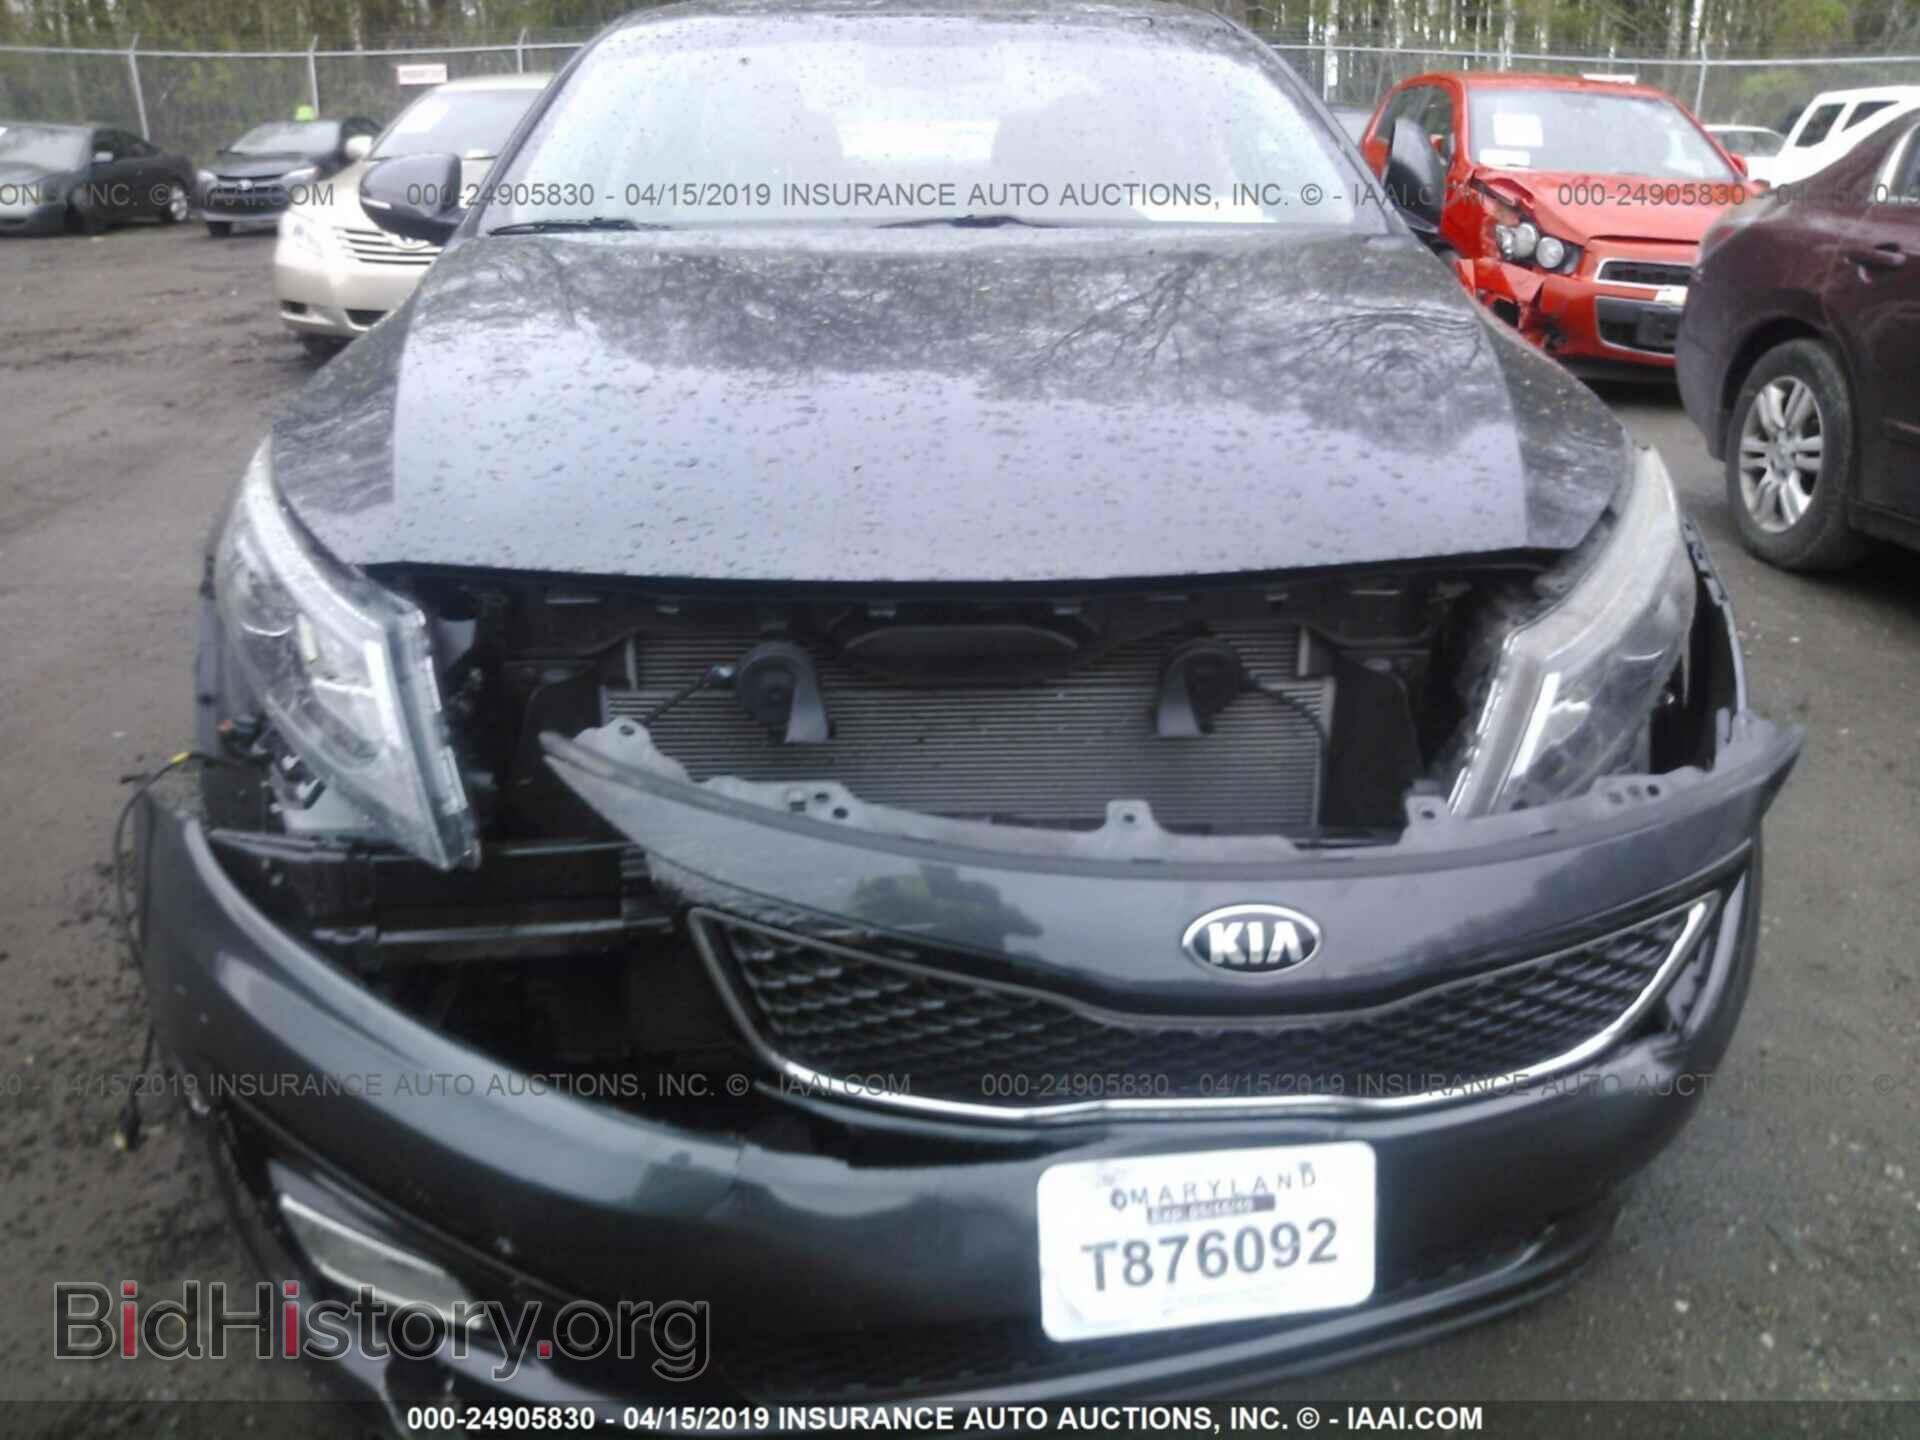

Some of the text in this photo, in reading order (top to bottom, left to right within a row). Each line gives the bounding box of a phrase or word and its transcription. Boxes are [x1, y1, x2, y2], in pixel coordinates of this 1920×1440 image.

[1207, 921, 1303, 964] KIA
[1129, 1168, 1317, 1205] MARYLAND
[1080, 1217, 1339, 1292] T876092
